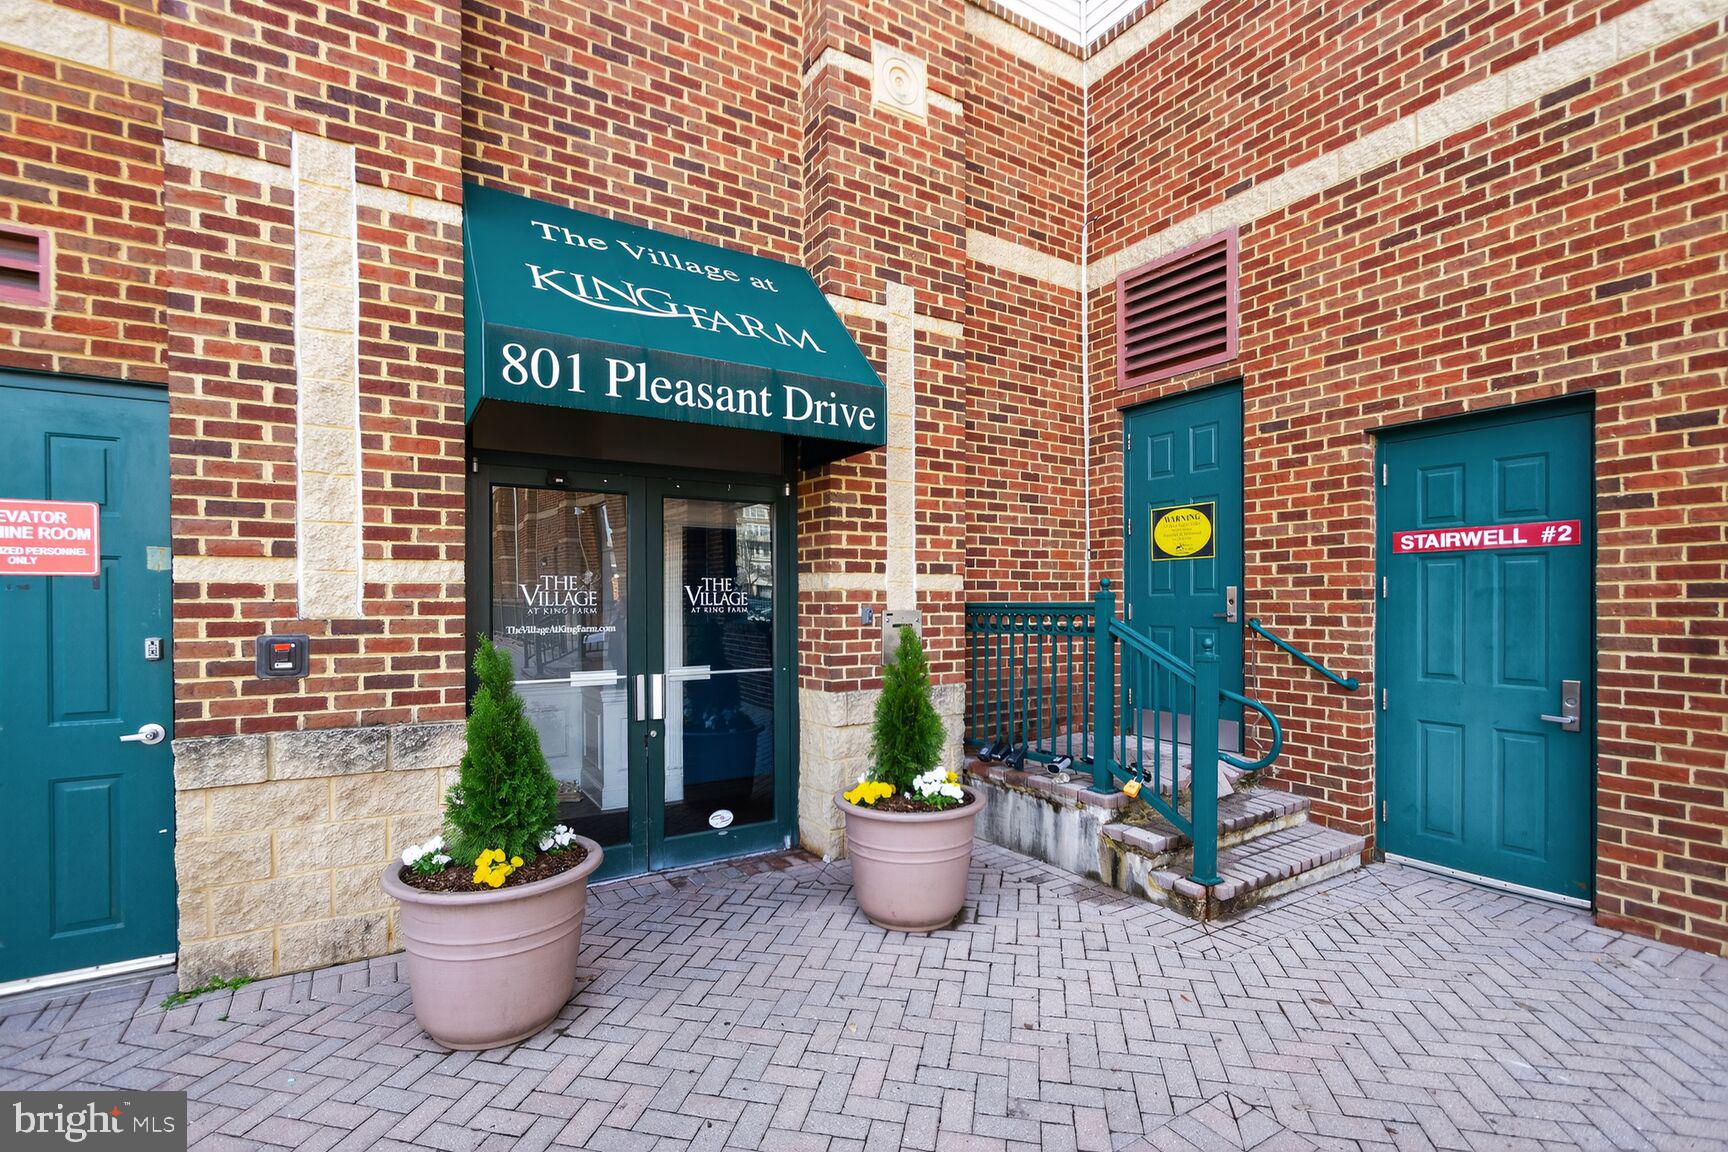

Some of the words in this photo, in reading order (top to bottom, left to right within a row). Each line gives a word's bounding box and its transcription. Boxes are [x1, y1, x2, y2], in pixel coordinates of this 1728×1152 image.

[531, 219, 608, 251] The
[616, 239, 741, 282] Village
[751, 274, 779, 293] at
[501, 343, 586, 394] 801
[604, 357, 773, 418] Pleasant
[782, 385, 876, 432] Drive
[1163, 512, 1201, 523] WARNING
[38, 527, 91, 541] ROOM
[1400, 528, 1527, 550] STAIRWELL
[1540, 525, 1572, 543] #2
[25, 546, 89, 557] PERSONNEL
[8, 556, 37, 565] ONLY
[540, 575, 578, 591] THE
[701, 577, 732, 592] THE
[519, 583, 597, 607] VILLAGE
[684, 585, 748, 607] VILLAGE
[527, 607, 540, 615] AT
[543, 607, 568, 615] KING
[572, 607, 597, 615] FARM
[727, 606, 748, 614] FARM
[505, 625, 617, 636] TheVillageAtKingFarm.com
